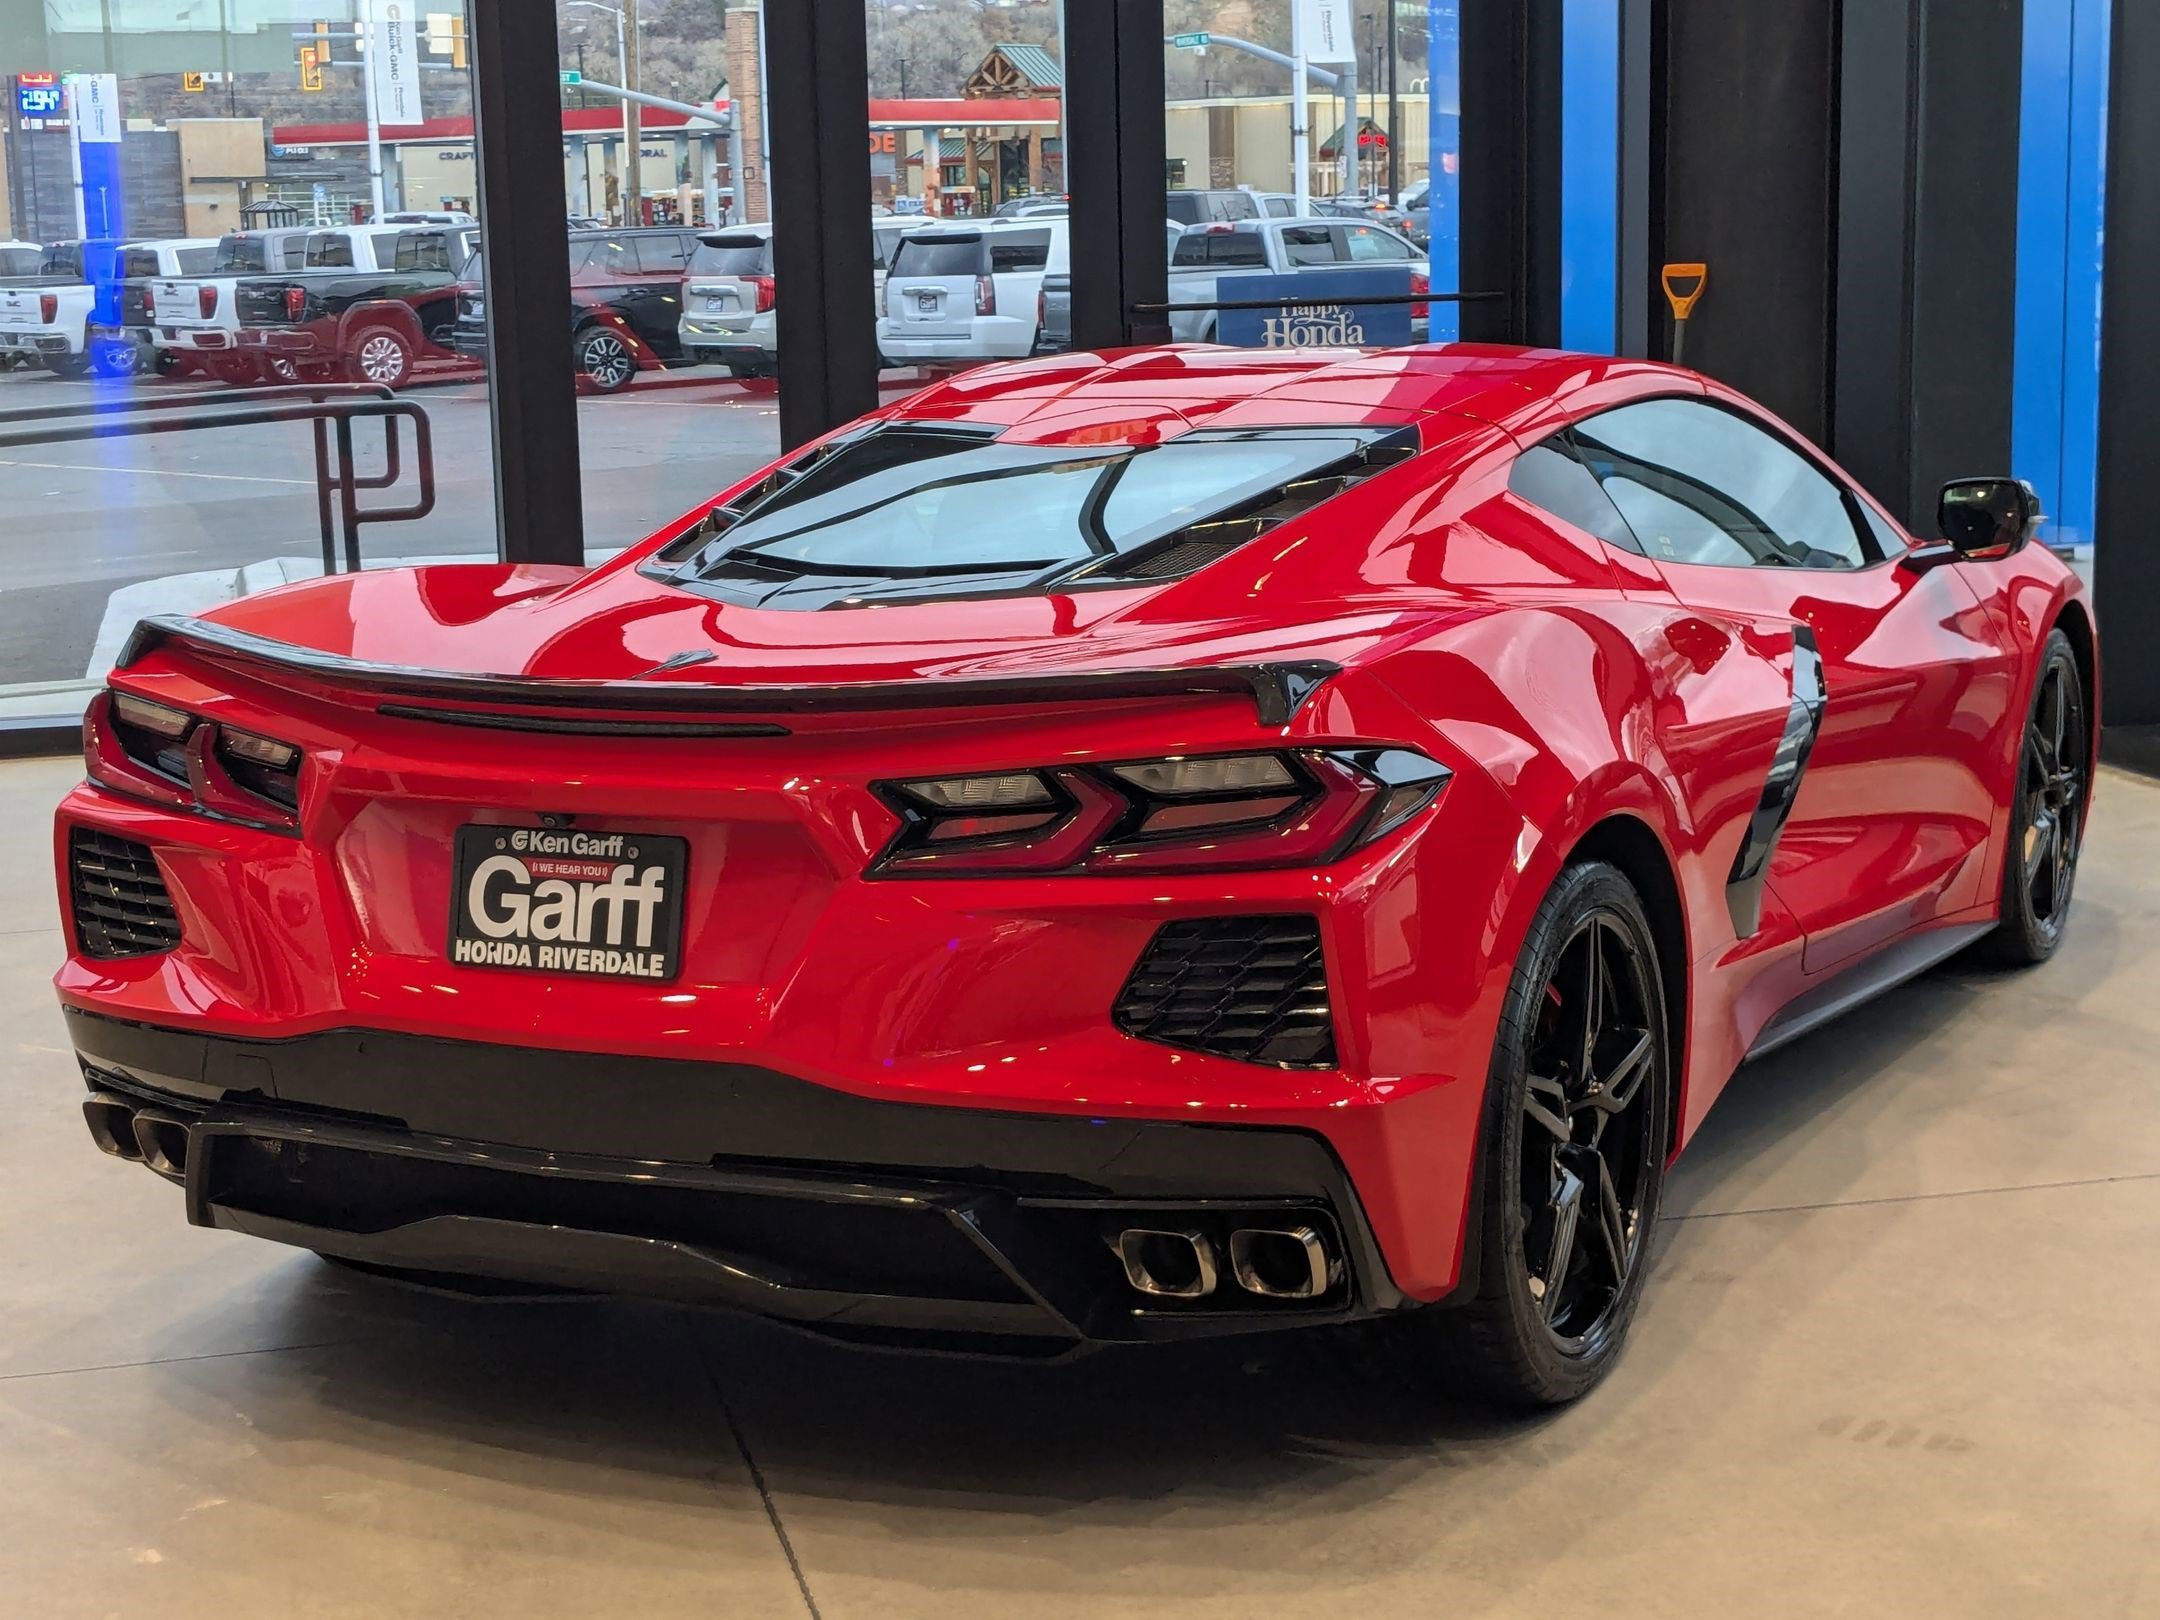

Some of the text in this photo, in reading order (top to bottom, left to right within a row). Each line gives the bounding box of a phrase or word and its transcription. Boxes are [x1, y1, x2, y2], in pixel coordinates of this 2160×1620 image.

[1280, 297, 1342, 320] Happy
[1261, 314, 1366, 349] Honda
[529, 830, 624, 857] Ken Garff
[539, 863, 602, 877] WE HEAR YOU
[469, 855, 665, 947] Garff
[455, 939, 665, 977] HONDA RIVERDALE
